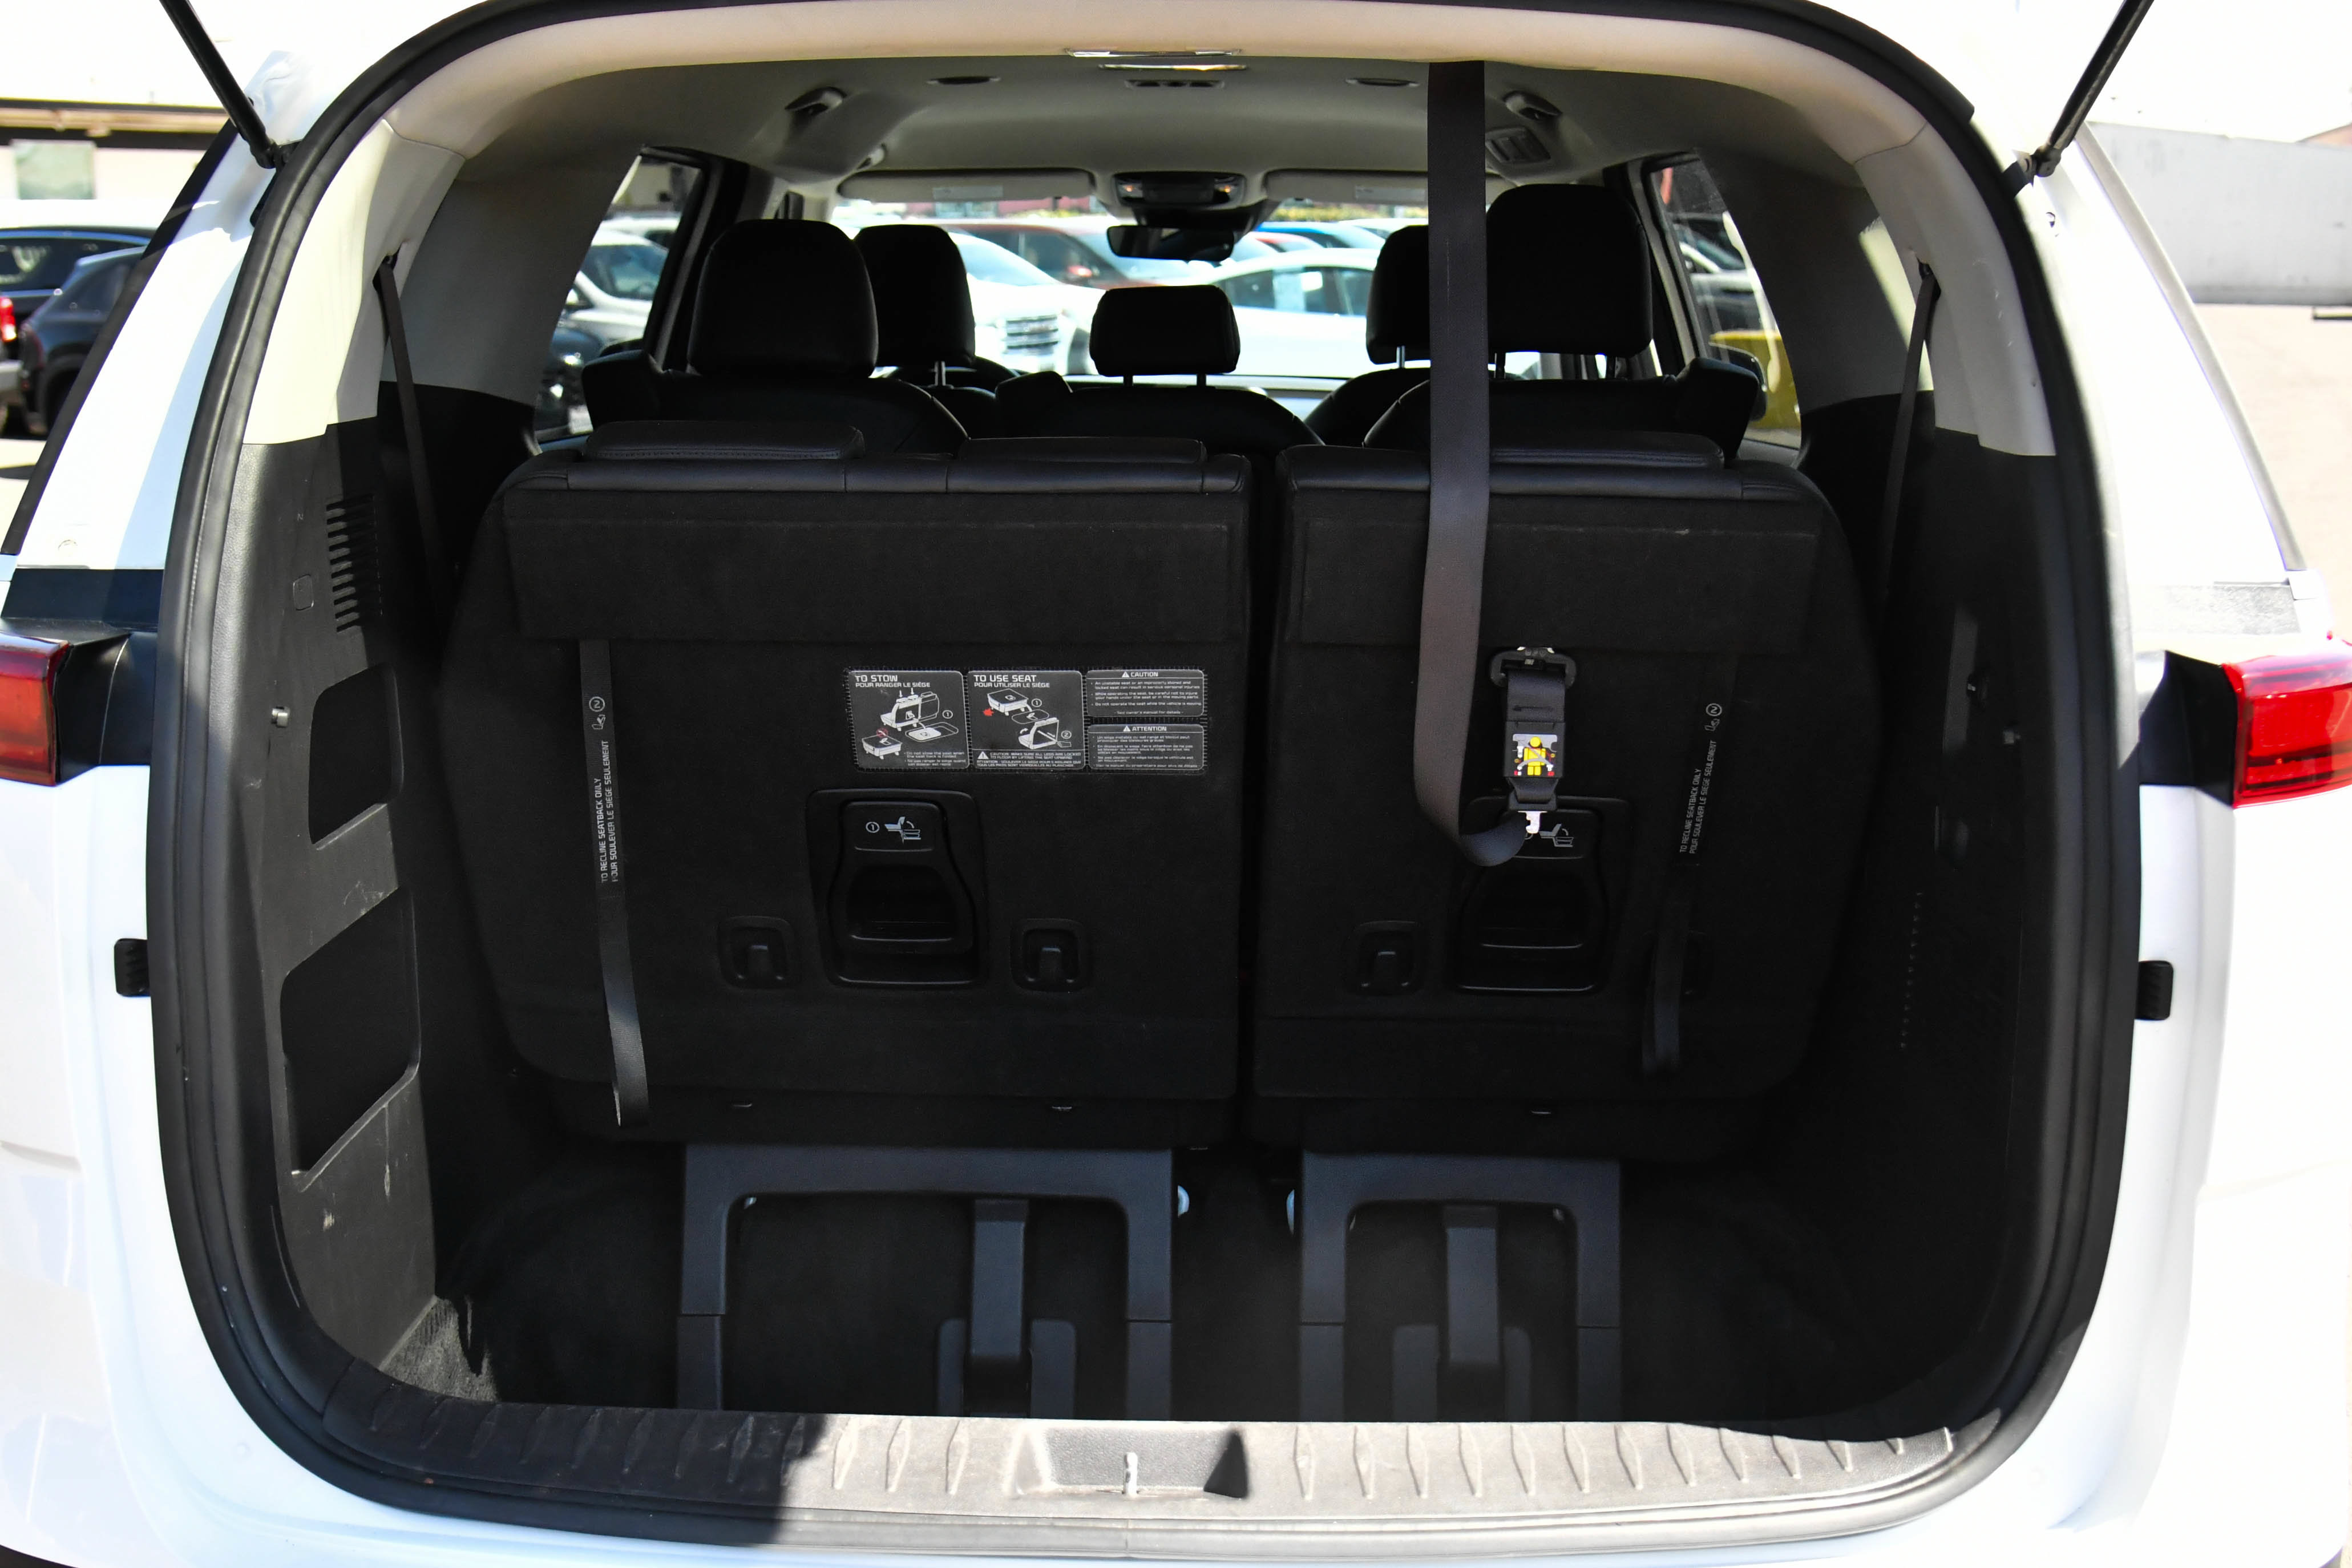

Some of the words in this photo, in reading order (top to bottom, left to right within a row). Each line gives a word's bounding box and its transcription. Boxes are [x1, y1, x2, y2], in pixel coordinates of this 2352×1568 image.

[601, 739, 611, 785] SEULEMENT
[1704, 739, 1716, 776] SEULEMENT
[1692, 768, 1702, 785] ONLY
[607, 810, 614, 820] LE
[1687, 786, 1699, 818] SEATBACK
[596, 799, 605, 839] SEATBACK
[1682, 819, 1692, 844] RECLINE
[1693, 806, 1705, 837] SOULEVER
[607, 822, 617, 860] SOULEVER
[1680, 844, 1687, 853] TO
[1689, 838, 1698, 854] POUR
[601, 872, 608, 883] TO
